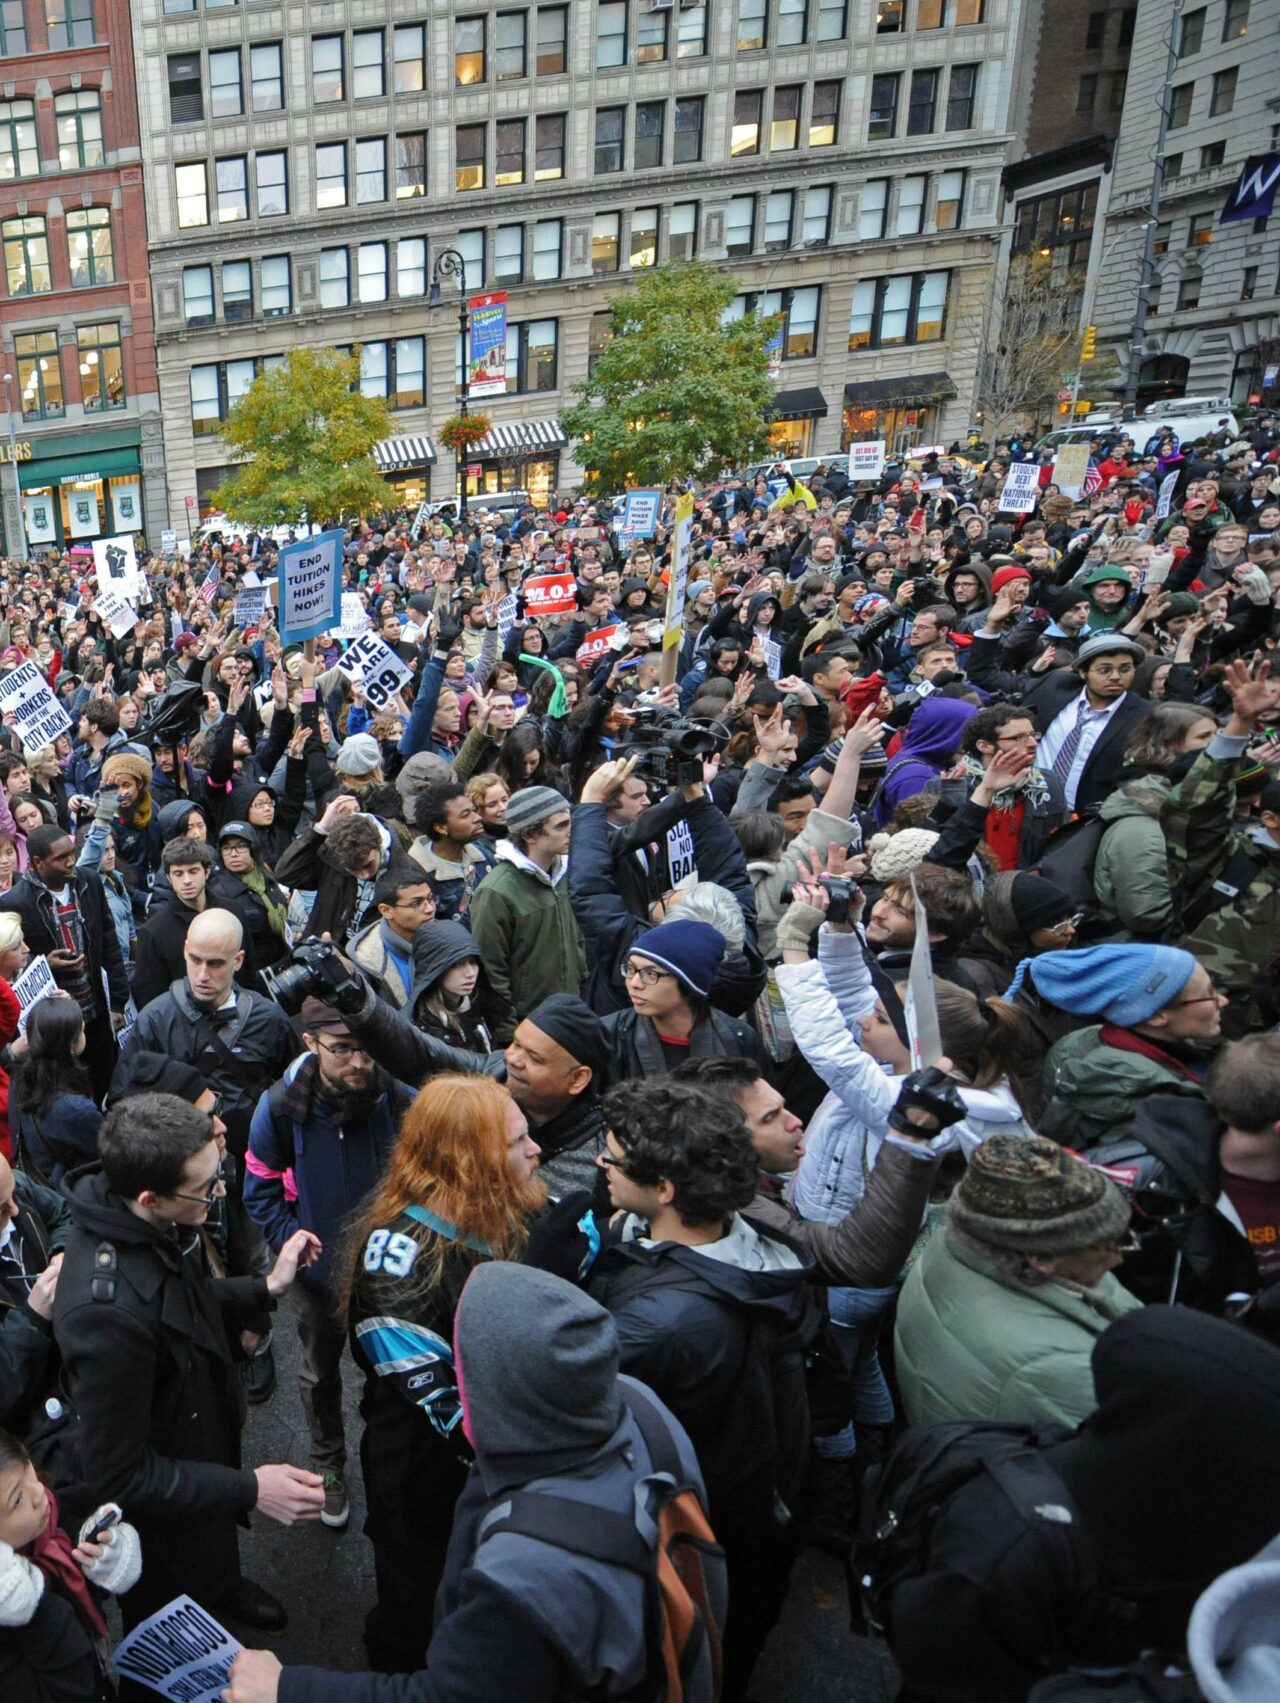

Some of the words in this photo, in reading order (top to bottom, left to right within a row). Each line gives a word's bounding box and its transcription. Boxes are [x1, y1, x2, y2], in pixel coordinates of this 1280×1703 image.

[490, 443, 545, 457] SEPHORA
[381, 460, 413, 471] HORA
[1012, 464, 1038, 475] STUDENT
[1014, 474, 1031, 485] DEBT
[1003, 489, 1034, 500] NATIONAL
[1003, 498, 1030, 509] THREAT!
[299, 552, 322, 569] END
[288, 564, 330, 586] TUITION
[293, 580, 326, 600] HIKES
[96, 598, 106, 608] WE
[105, 592, 115, 603] ARE
[104, 600, 117, 612] FREE
[294, 594, 325, 613] NOW!
[338, 635, 378, 672] WE
[361, 646, 390, 675] ARE
[362, 673, 376, 687] THE
[366, 668, 407, 706] 99%
[25, 714, 38, 729] TAKE
[37, 706, 50, 720] THE
[24, 726, 44, 752] CITY
[43, 708, 70, 741] BACK!
[364, 1228, 418, 1278] 89
[116, 1604, 228, 1684] OCCUPATION
